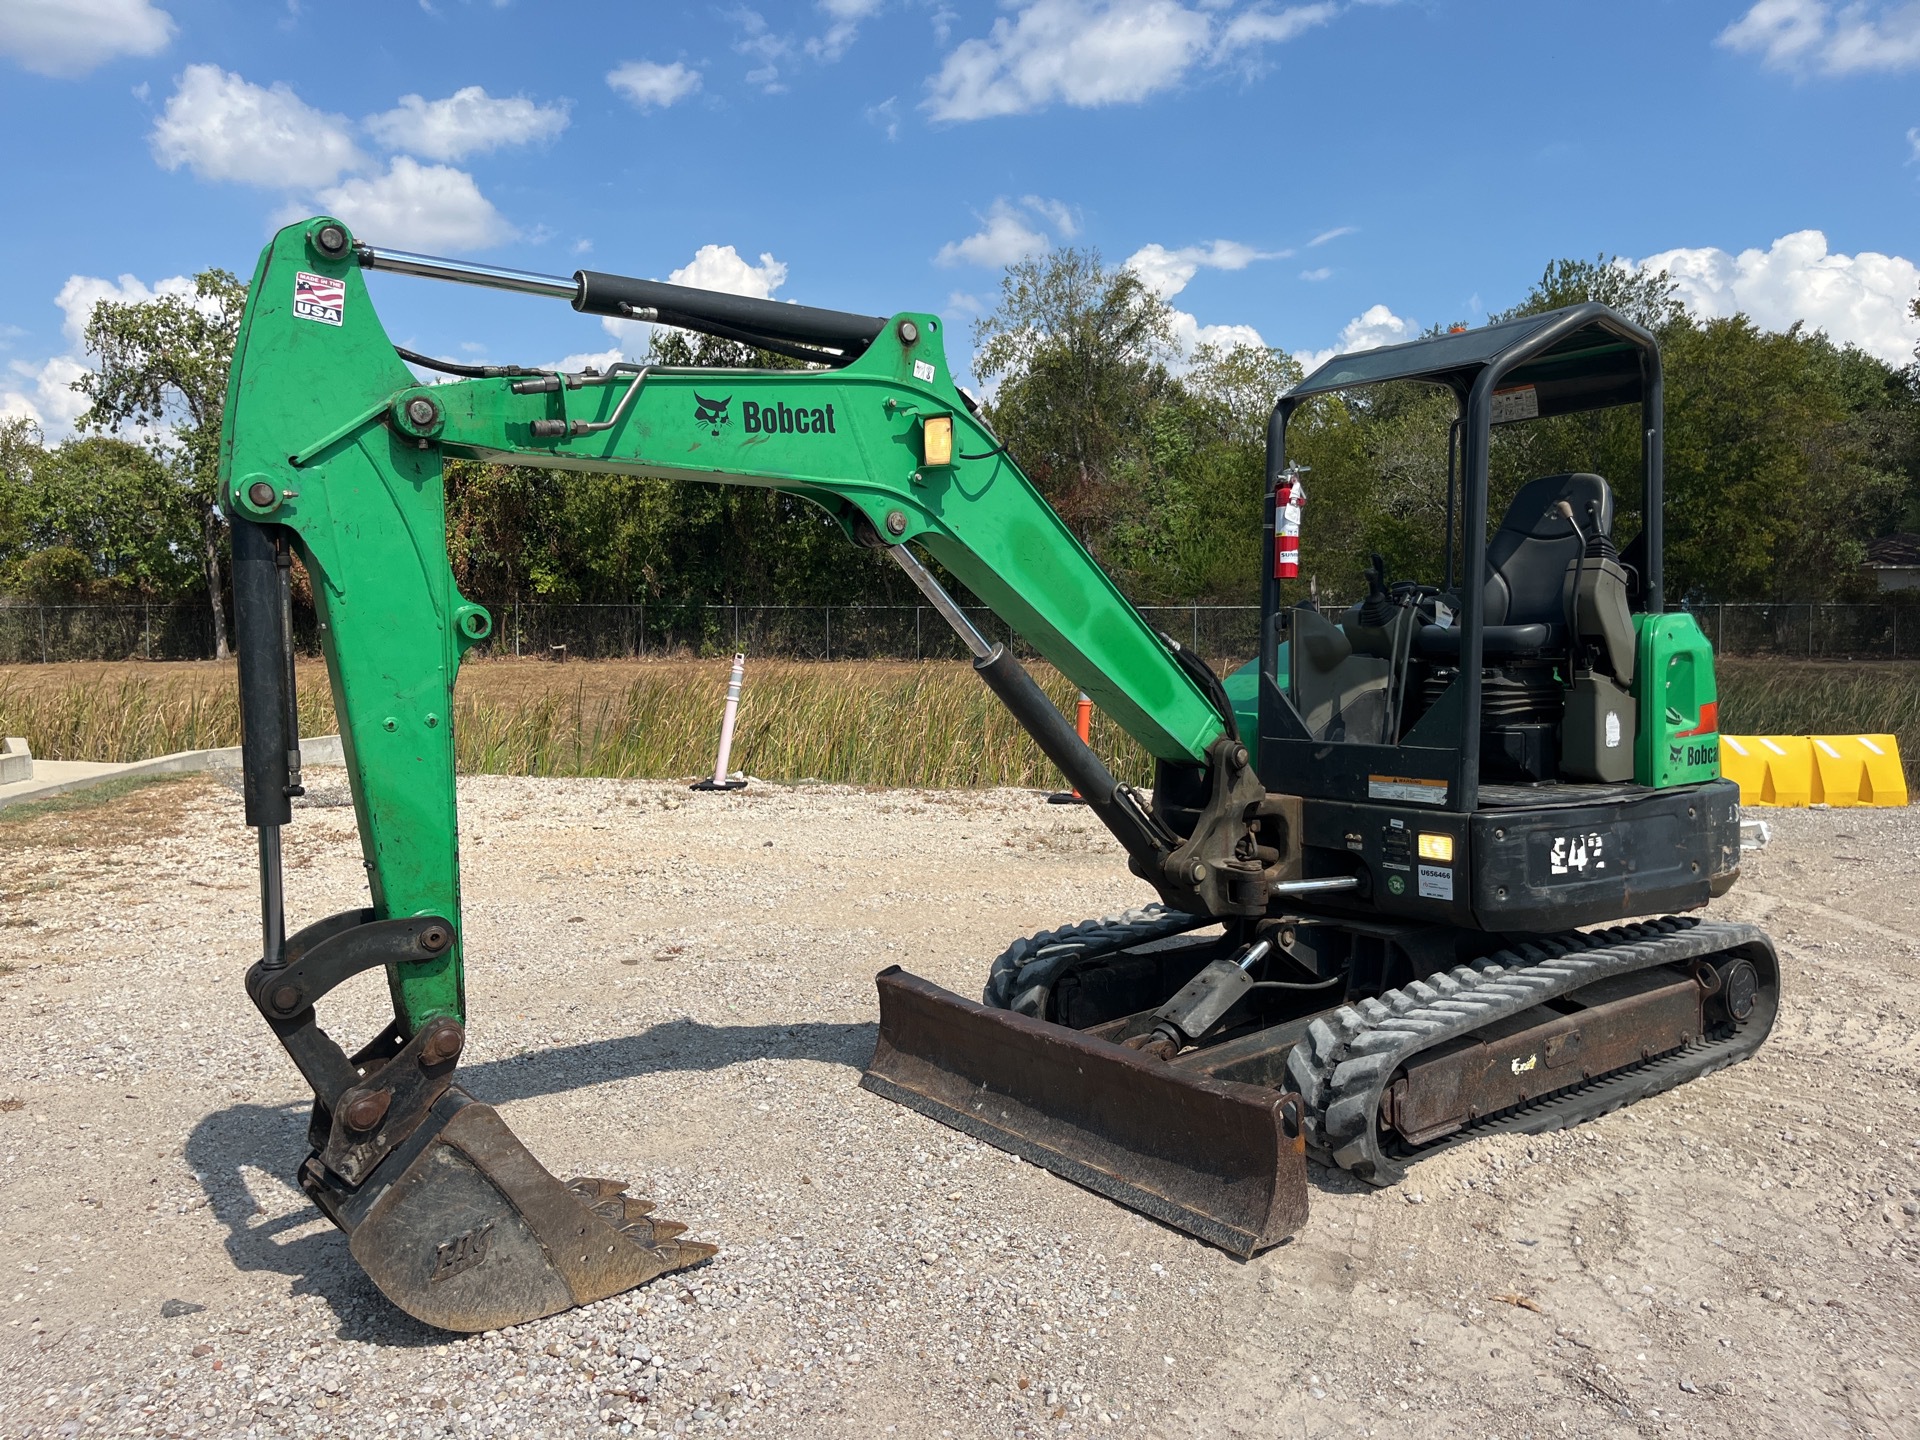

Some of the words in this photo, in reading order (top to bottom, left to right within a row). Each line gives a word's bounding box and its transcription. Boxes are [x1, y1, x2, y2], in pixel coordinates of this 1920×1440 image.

[299, 273, 319, 283] MADE
[329, 280, 342, 289] THE
[297, 302, 339, 322] USA
[742, 401, 836, 434] Bobcat
[1420, 869, 1451, 880] U656466
